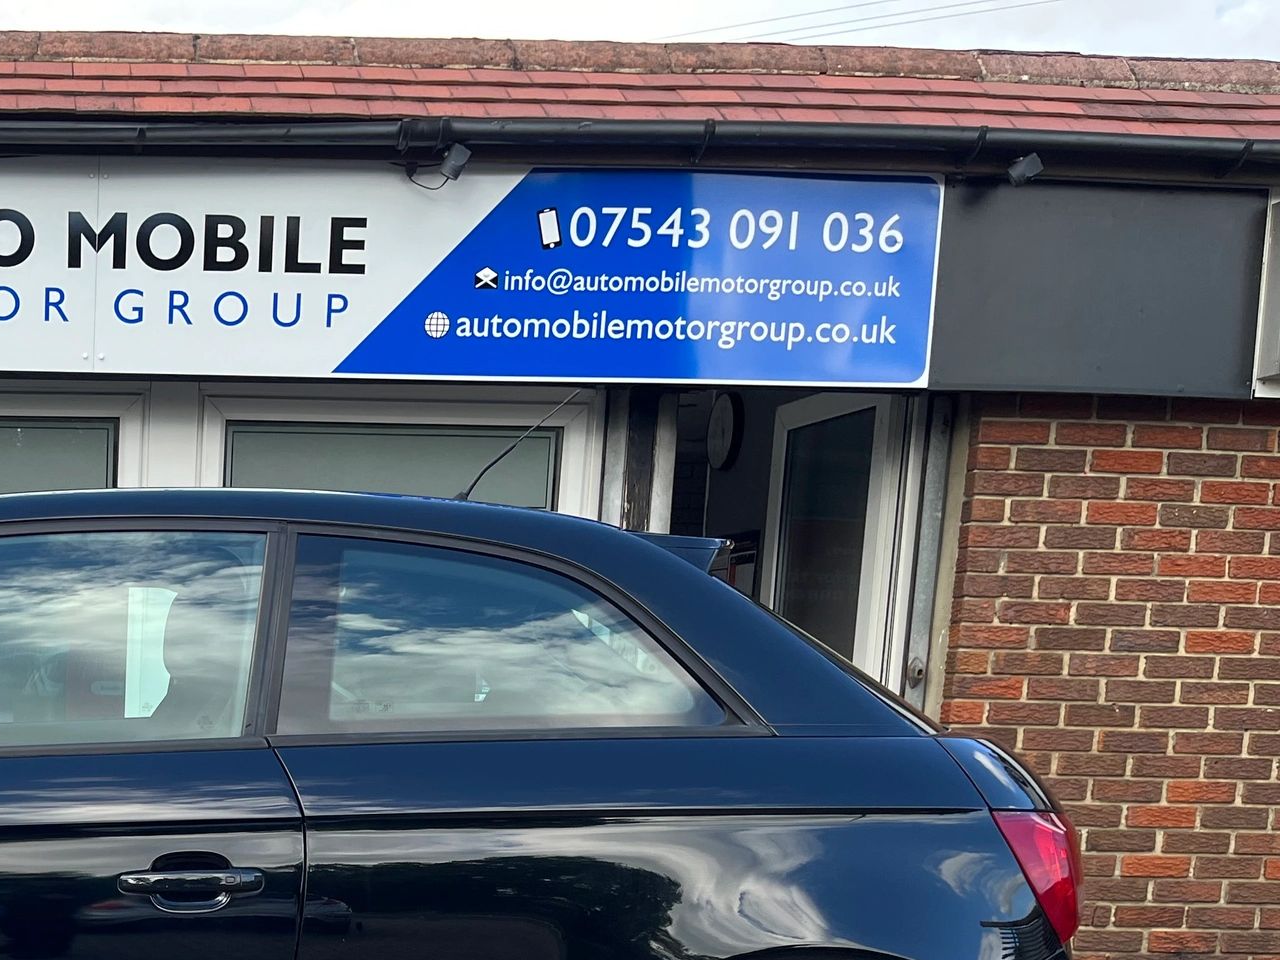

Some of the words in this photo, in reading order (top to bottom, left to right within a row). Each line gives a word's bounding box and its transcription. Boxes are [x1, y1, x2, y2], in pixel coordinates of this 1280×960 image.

[67, 212, 368, 275] MOBILE
[569, 206, 711, 249] 07543
[729, 208, 799, 251] 091
[822, 211, 904, 254] 036
[504, 268, 901, 302] info@automobilemotorgroup.co.uk
[113, 288, 349, 328] GROUP
[456, 310, 897, 351] automobilemotorgroup.co.uk
